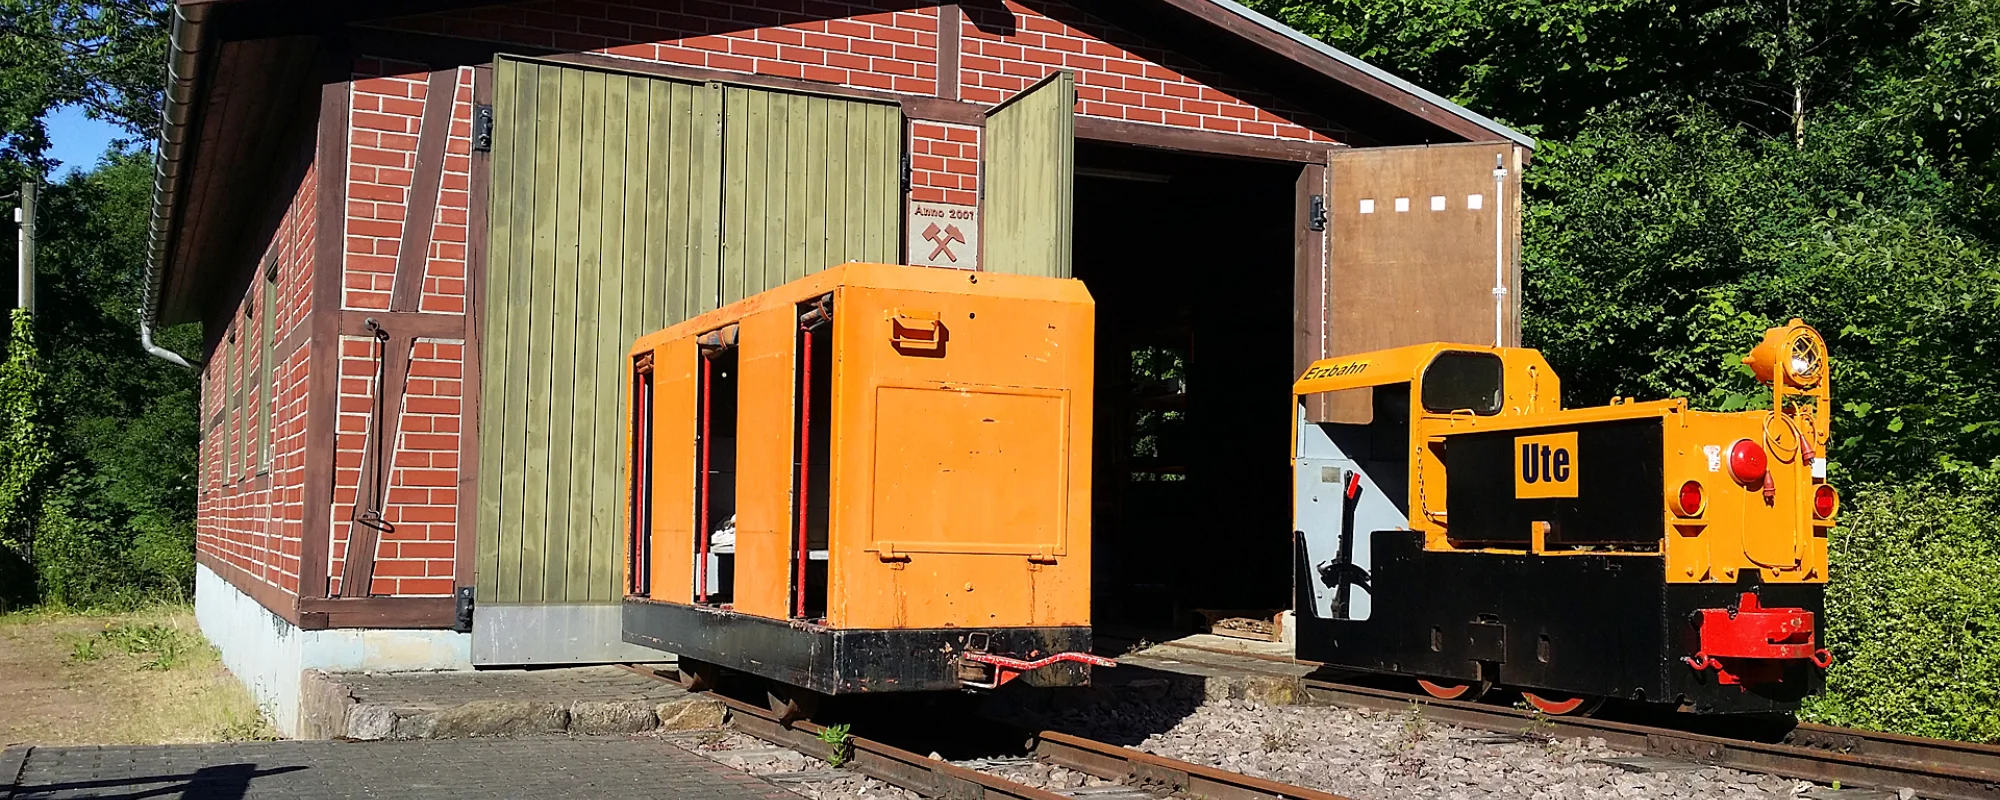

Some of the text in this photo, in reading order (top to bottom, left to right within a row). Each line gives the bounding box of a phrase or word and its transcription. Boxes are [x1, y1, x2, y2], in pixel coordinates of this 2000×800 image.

[914, 204, 944, 218] Anno
[1303, 362, 1368, 381] Erzbahn
[1522, 443, 1570, 484] Ute
